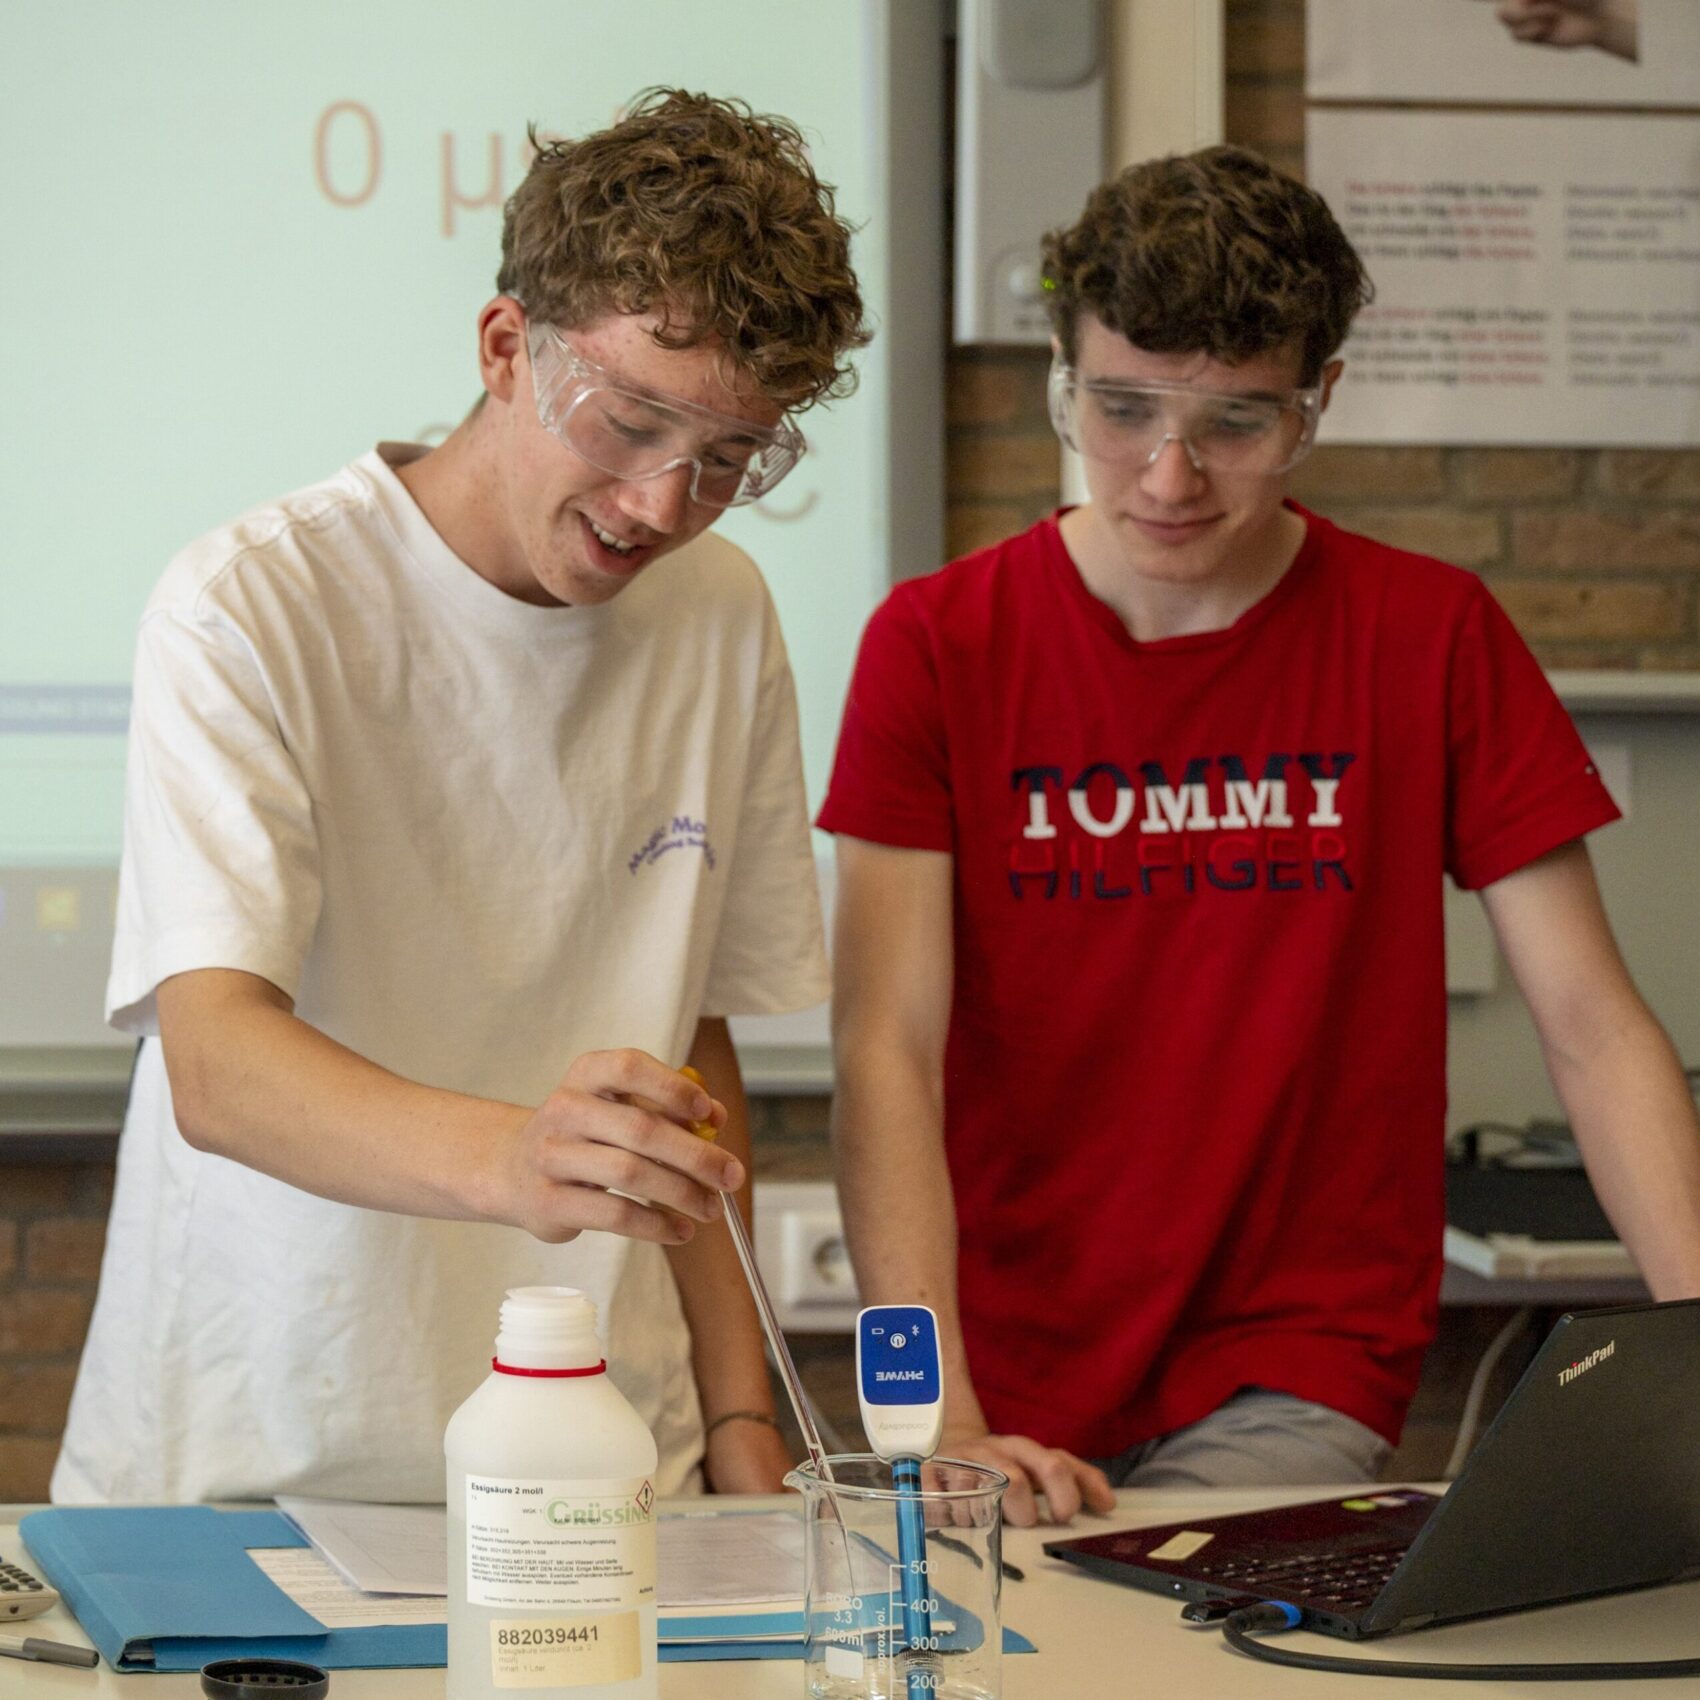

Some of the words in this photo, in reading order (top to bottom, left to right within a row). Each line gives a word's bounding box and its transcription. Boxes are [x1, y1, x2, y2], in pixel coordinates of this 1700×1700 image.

[313, 99, 384, 208] 0
[1010, 752, 1357, 840] TOMMY
[1008, 832, 1355, 900] HILFIGER
[1557, 1339, 1616, 1387] ThinkPad
[874, 1370, 925, 1382] PHYWE
[471, 1481, 513, 1495] Essigsäure
[514, 1486, 520, 1495] 2
[522, 1486, 544, 1495] mol/l
[910, 1560, 939, 1574] 500
[910, 1598, 939, 1613] 400
[834, 1609, 853, 1624] 3.3
[498, 1625, 599, 1646] 882039441
[910, 1636, 939, 1651] 300
[910, 1675, 939, 1690] 200
